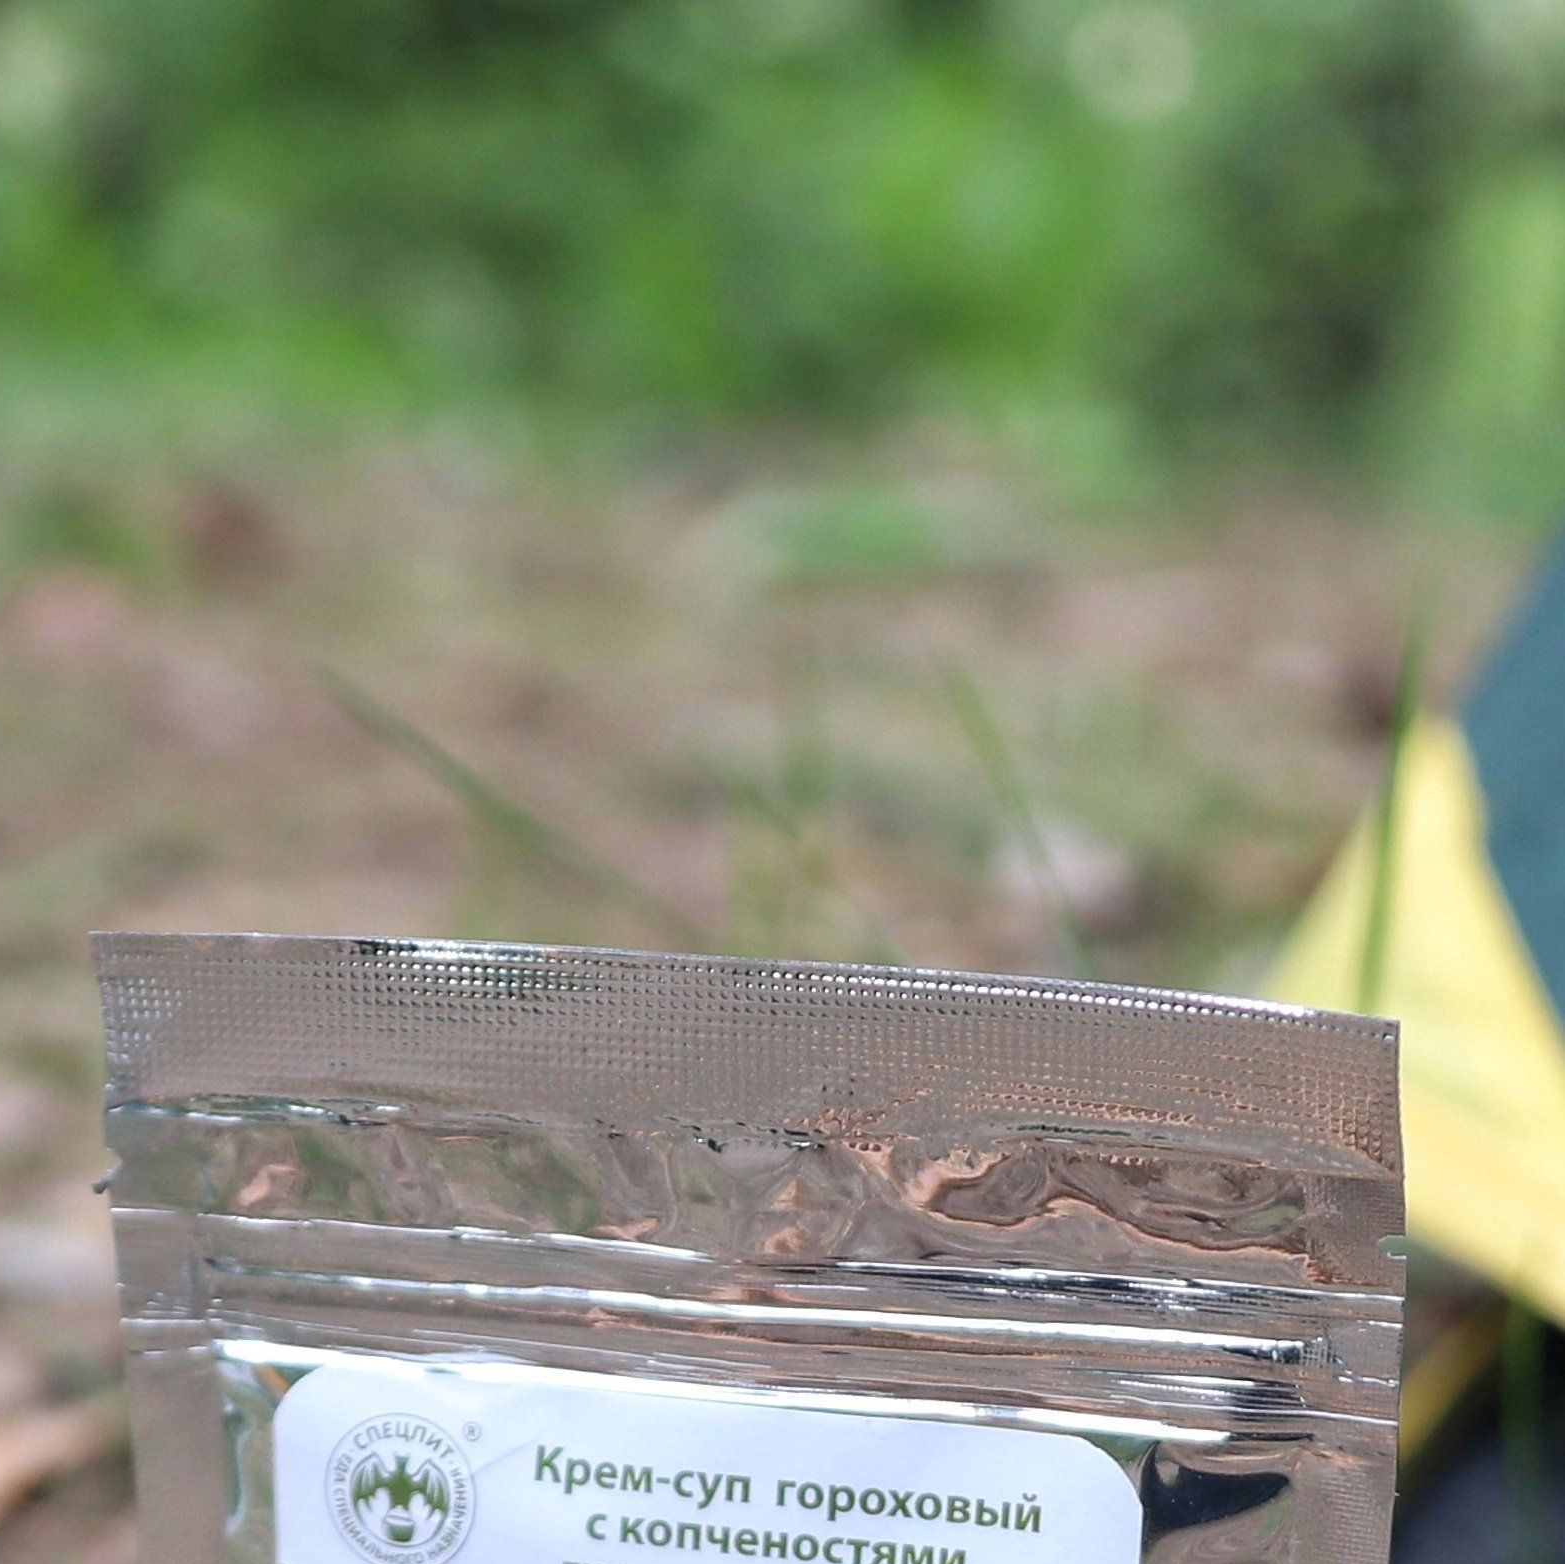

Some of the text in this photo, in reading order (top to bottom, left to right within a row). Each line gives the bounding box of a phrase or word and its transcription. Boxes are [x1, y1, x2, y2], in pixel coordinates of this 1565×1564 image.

[353, 1421, 455, 1459] СПЕЦПИТ
[534, 1445, 1043, 1533] Крем-суп гороховый
[586, 1513, 606, 1540] с
